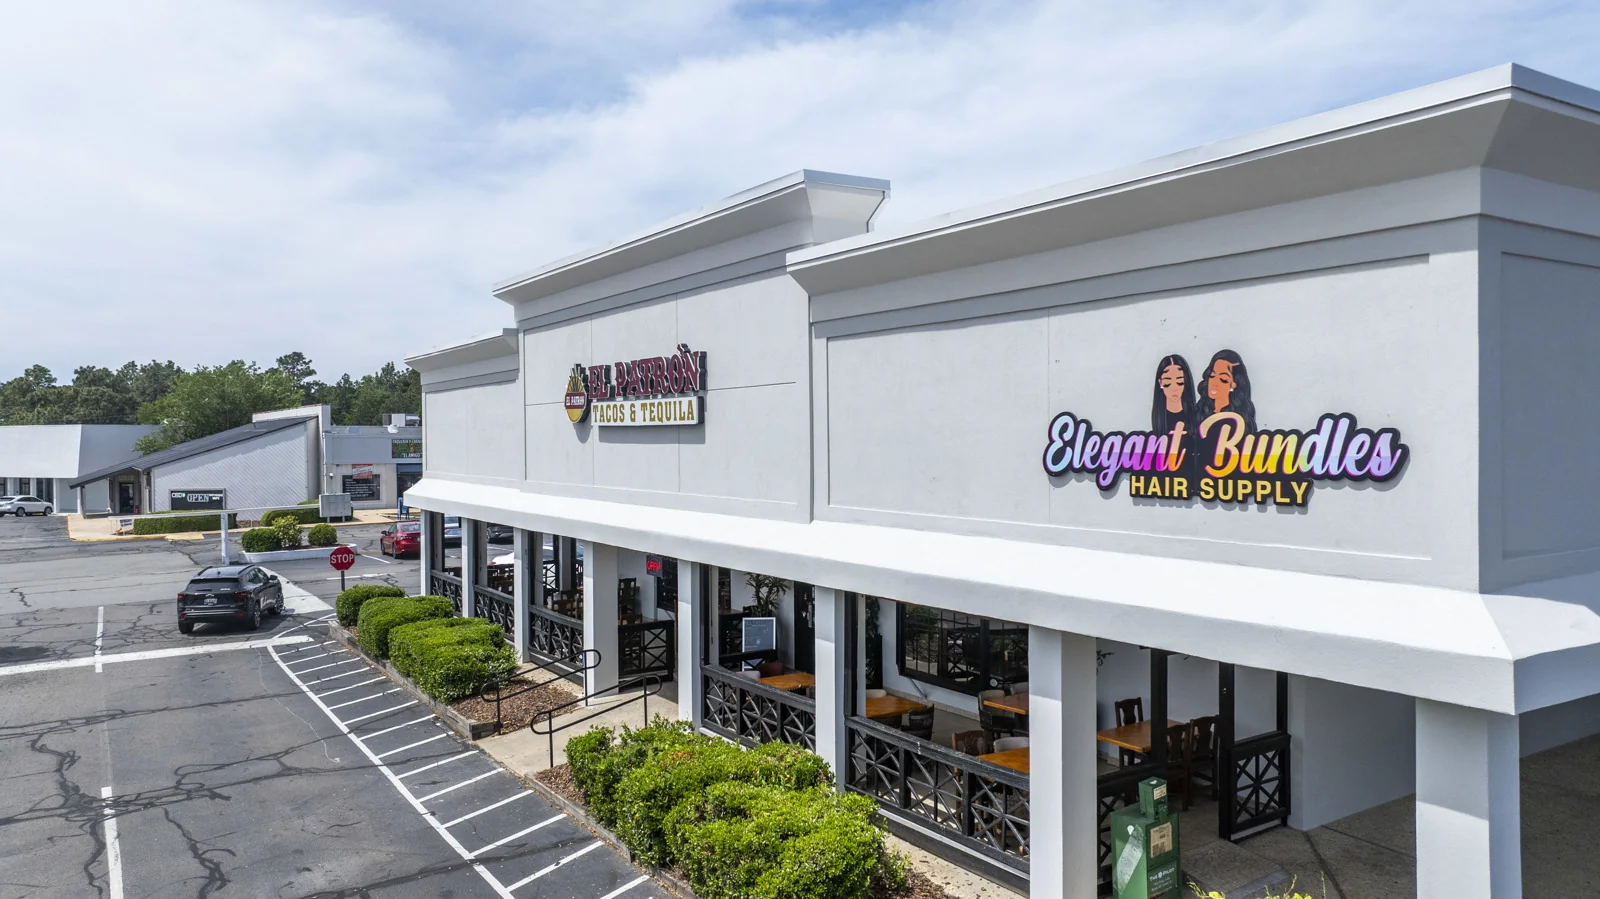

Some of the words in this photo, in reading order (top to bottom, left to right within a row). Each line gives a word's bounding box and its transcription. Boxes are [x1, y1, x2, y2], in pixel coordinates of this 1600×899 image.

[588, 365, 610, 399] EL
[593, 403, 625, 423] TACOS
[630, 403, 636, 422] &
[641, 400, 695, 423] TEQUILA
[1045, 415, 1186, 487] Elegant
[1198, 411, 1402, 477] Bundles
[187, 494, 209, 502] OPEN
[1131, 475, 1188, 498] HAIR
[1200, 478, 1308, 504] SUPPLY
[331, 554, 354, 563] STOP
